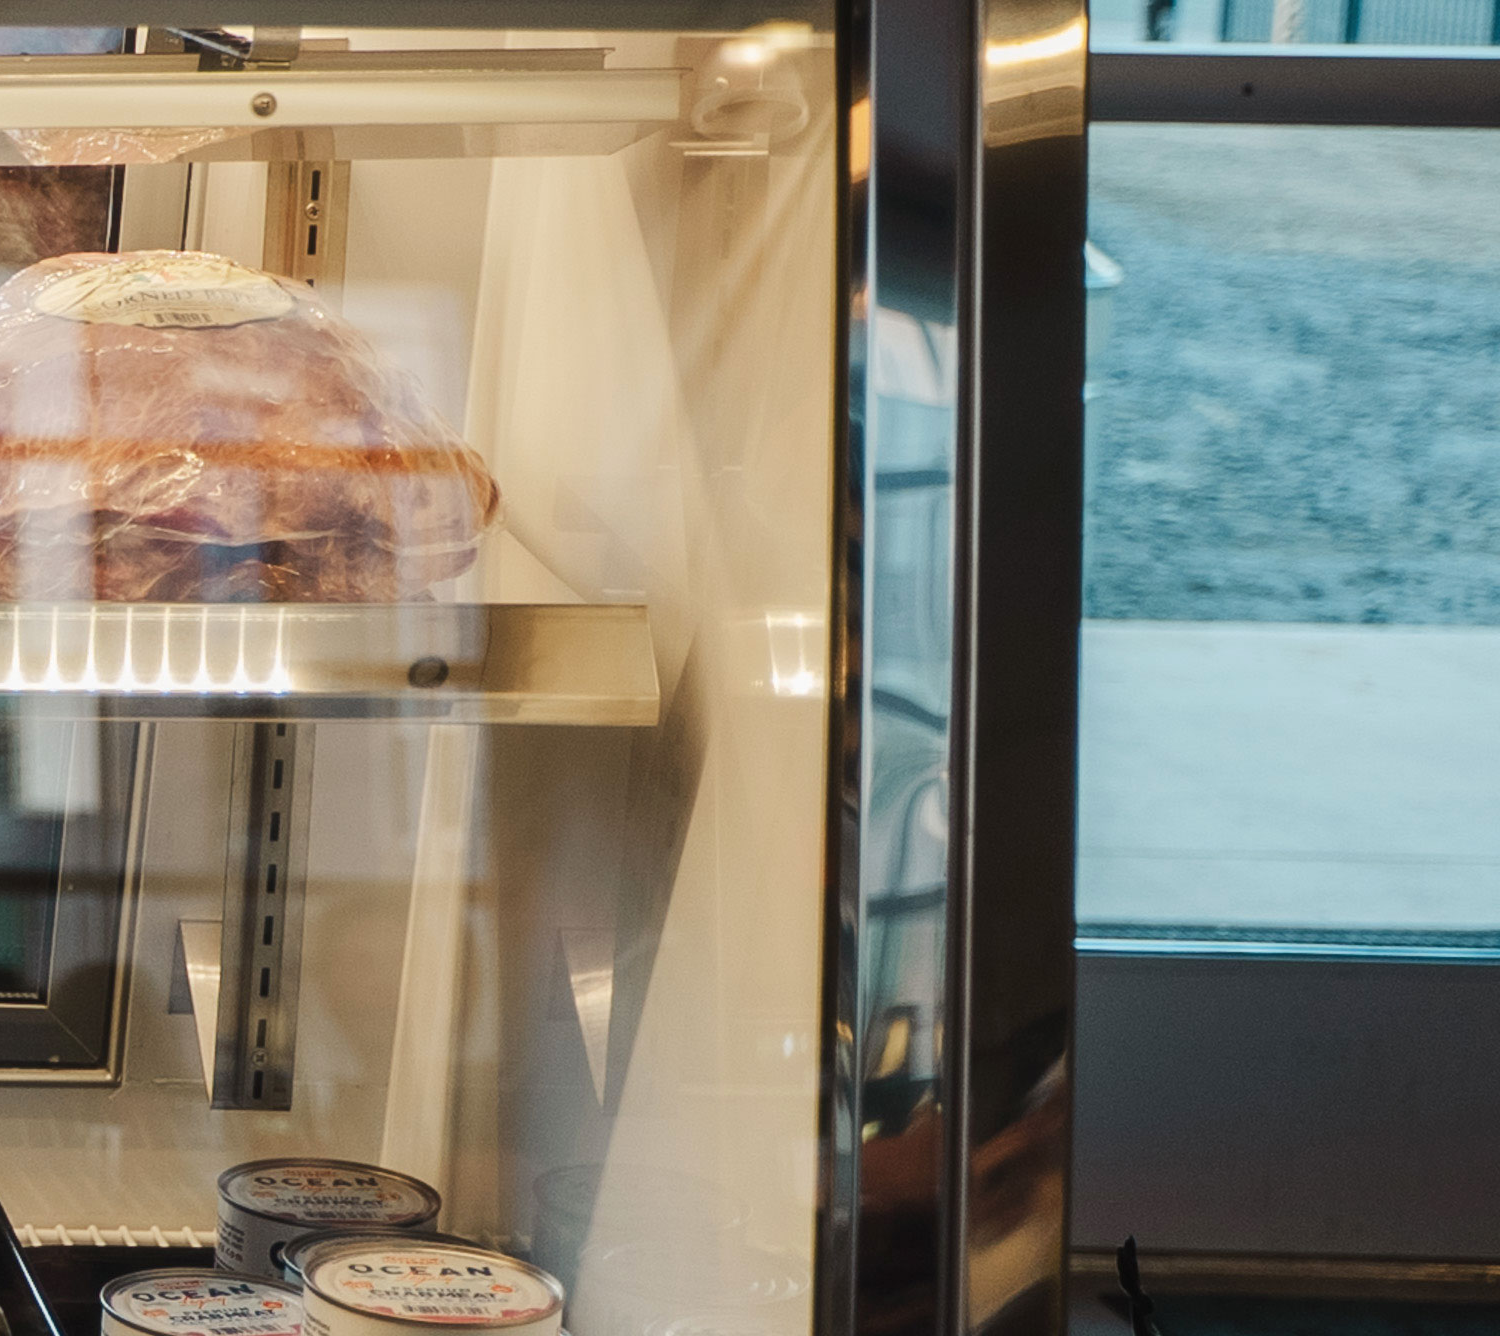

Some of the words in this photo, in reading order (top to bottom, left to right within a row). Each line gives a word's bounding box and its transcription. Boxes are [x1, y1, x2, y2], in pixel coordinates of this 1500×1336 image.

[253, 1175, 379, 1189] OCEAN
[347, 1263, 493, 1278] OCEAN
[131, 1283, 256, 1303] OCEAN
